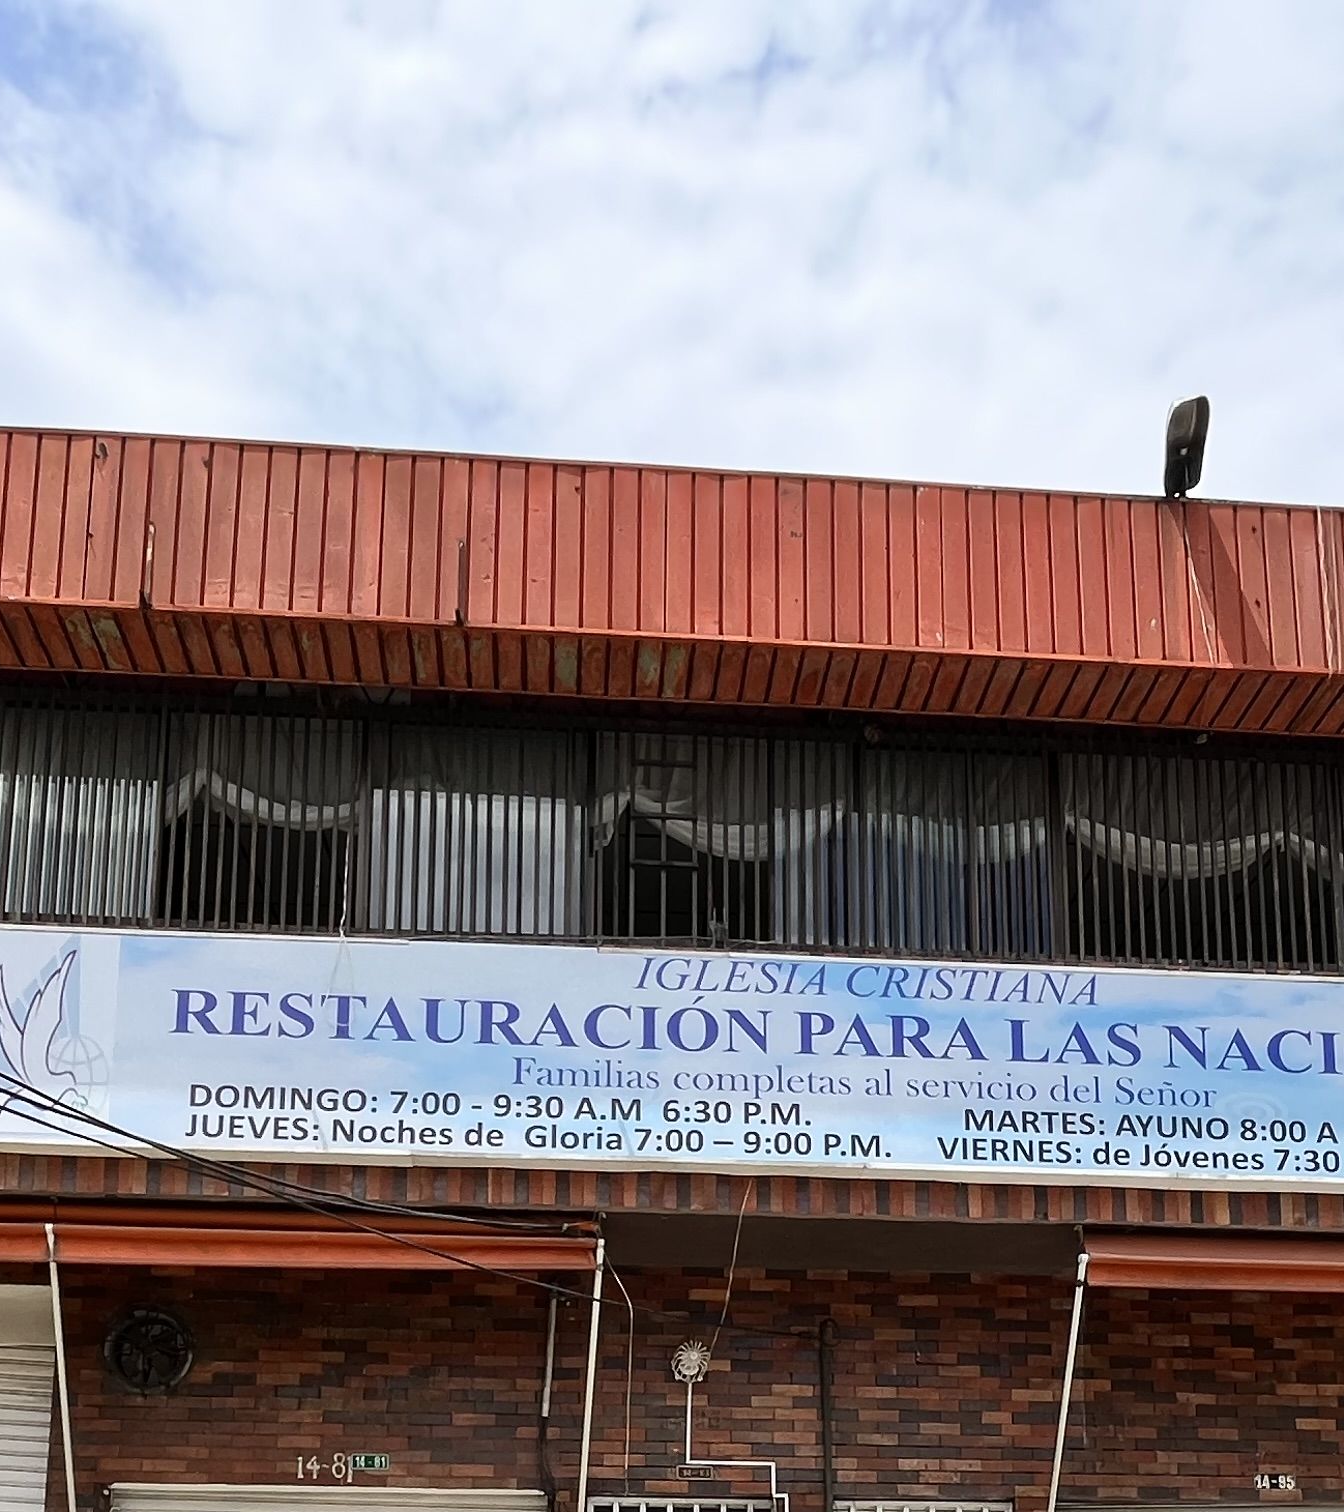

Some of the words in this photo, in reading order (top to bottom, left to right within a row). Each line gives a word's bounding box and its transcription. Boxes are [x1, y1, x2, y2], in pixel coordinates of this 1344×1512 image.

[633, 956, 829, 996] IGLESIA
[846, 964, 1099, 1007] CRISTIANA
[168, 988, 773, 1054] RESTAURACIÓN
[793, 1010, 990, 1062] PARA
[1004, 1018, 1142, 1068] LAS
[188, 1083, 378, 1114] DOMINGO:
[389, 1090, 462, 1116] 7:00
[493, 1094, 565, 1120] 9:30
[573, 1097, 643, 1122] A.M
[662, 1099, 733, 1125] 6:30
[743, 1102, 813, 1127] P.M.
[512, 1056, 660, 1090] Familias
[673, 1065, 852, 1099] completas
[864, 1068, 894, 1097] al
[905, 1070, 1037, 1102] servicio
[1049, 1074, 1102, 1104] del
[1114, 1076, 1218, 1109] Señor
[184, 1113, 320, 1142] JUEVES:
[331, 1118, 454, 1147] Noches
[463, 1122, 505, 1148] de
[524, 1124, 623, 1152] Gloria
[634, 1127, 705, 1153] 7:00
[742, 1130, 813, 1156] 9:00
[823, 1133, 893, 1159] P.M.
[963, 1108, 1106, 1136] MARTES:
[1115, 1114, 1230, 1141] AYUNO
[1238, 1118, 1307, 1145] 8:00
[1315, 1121, 1340, 1145] A
[936, 1136, 1082, 1165] VIERNES:
[1091, 1141, 1131, 1167] de
[1139, 1143, 1265, 1171] Jóvenes
[1272, 1147, 1341, 1174] 7:30
